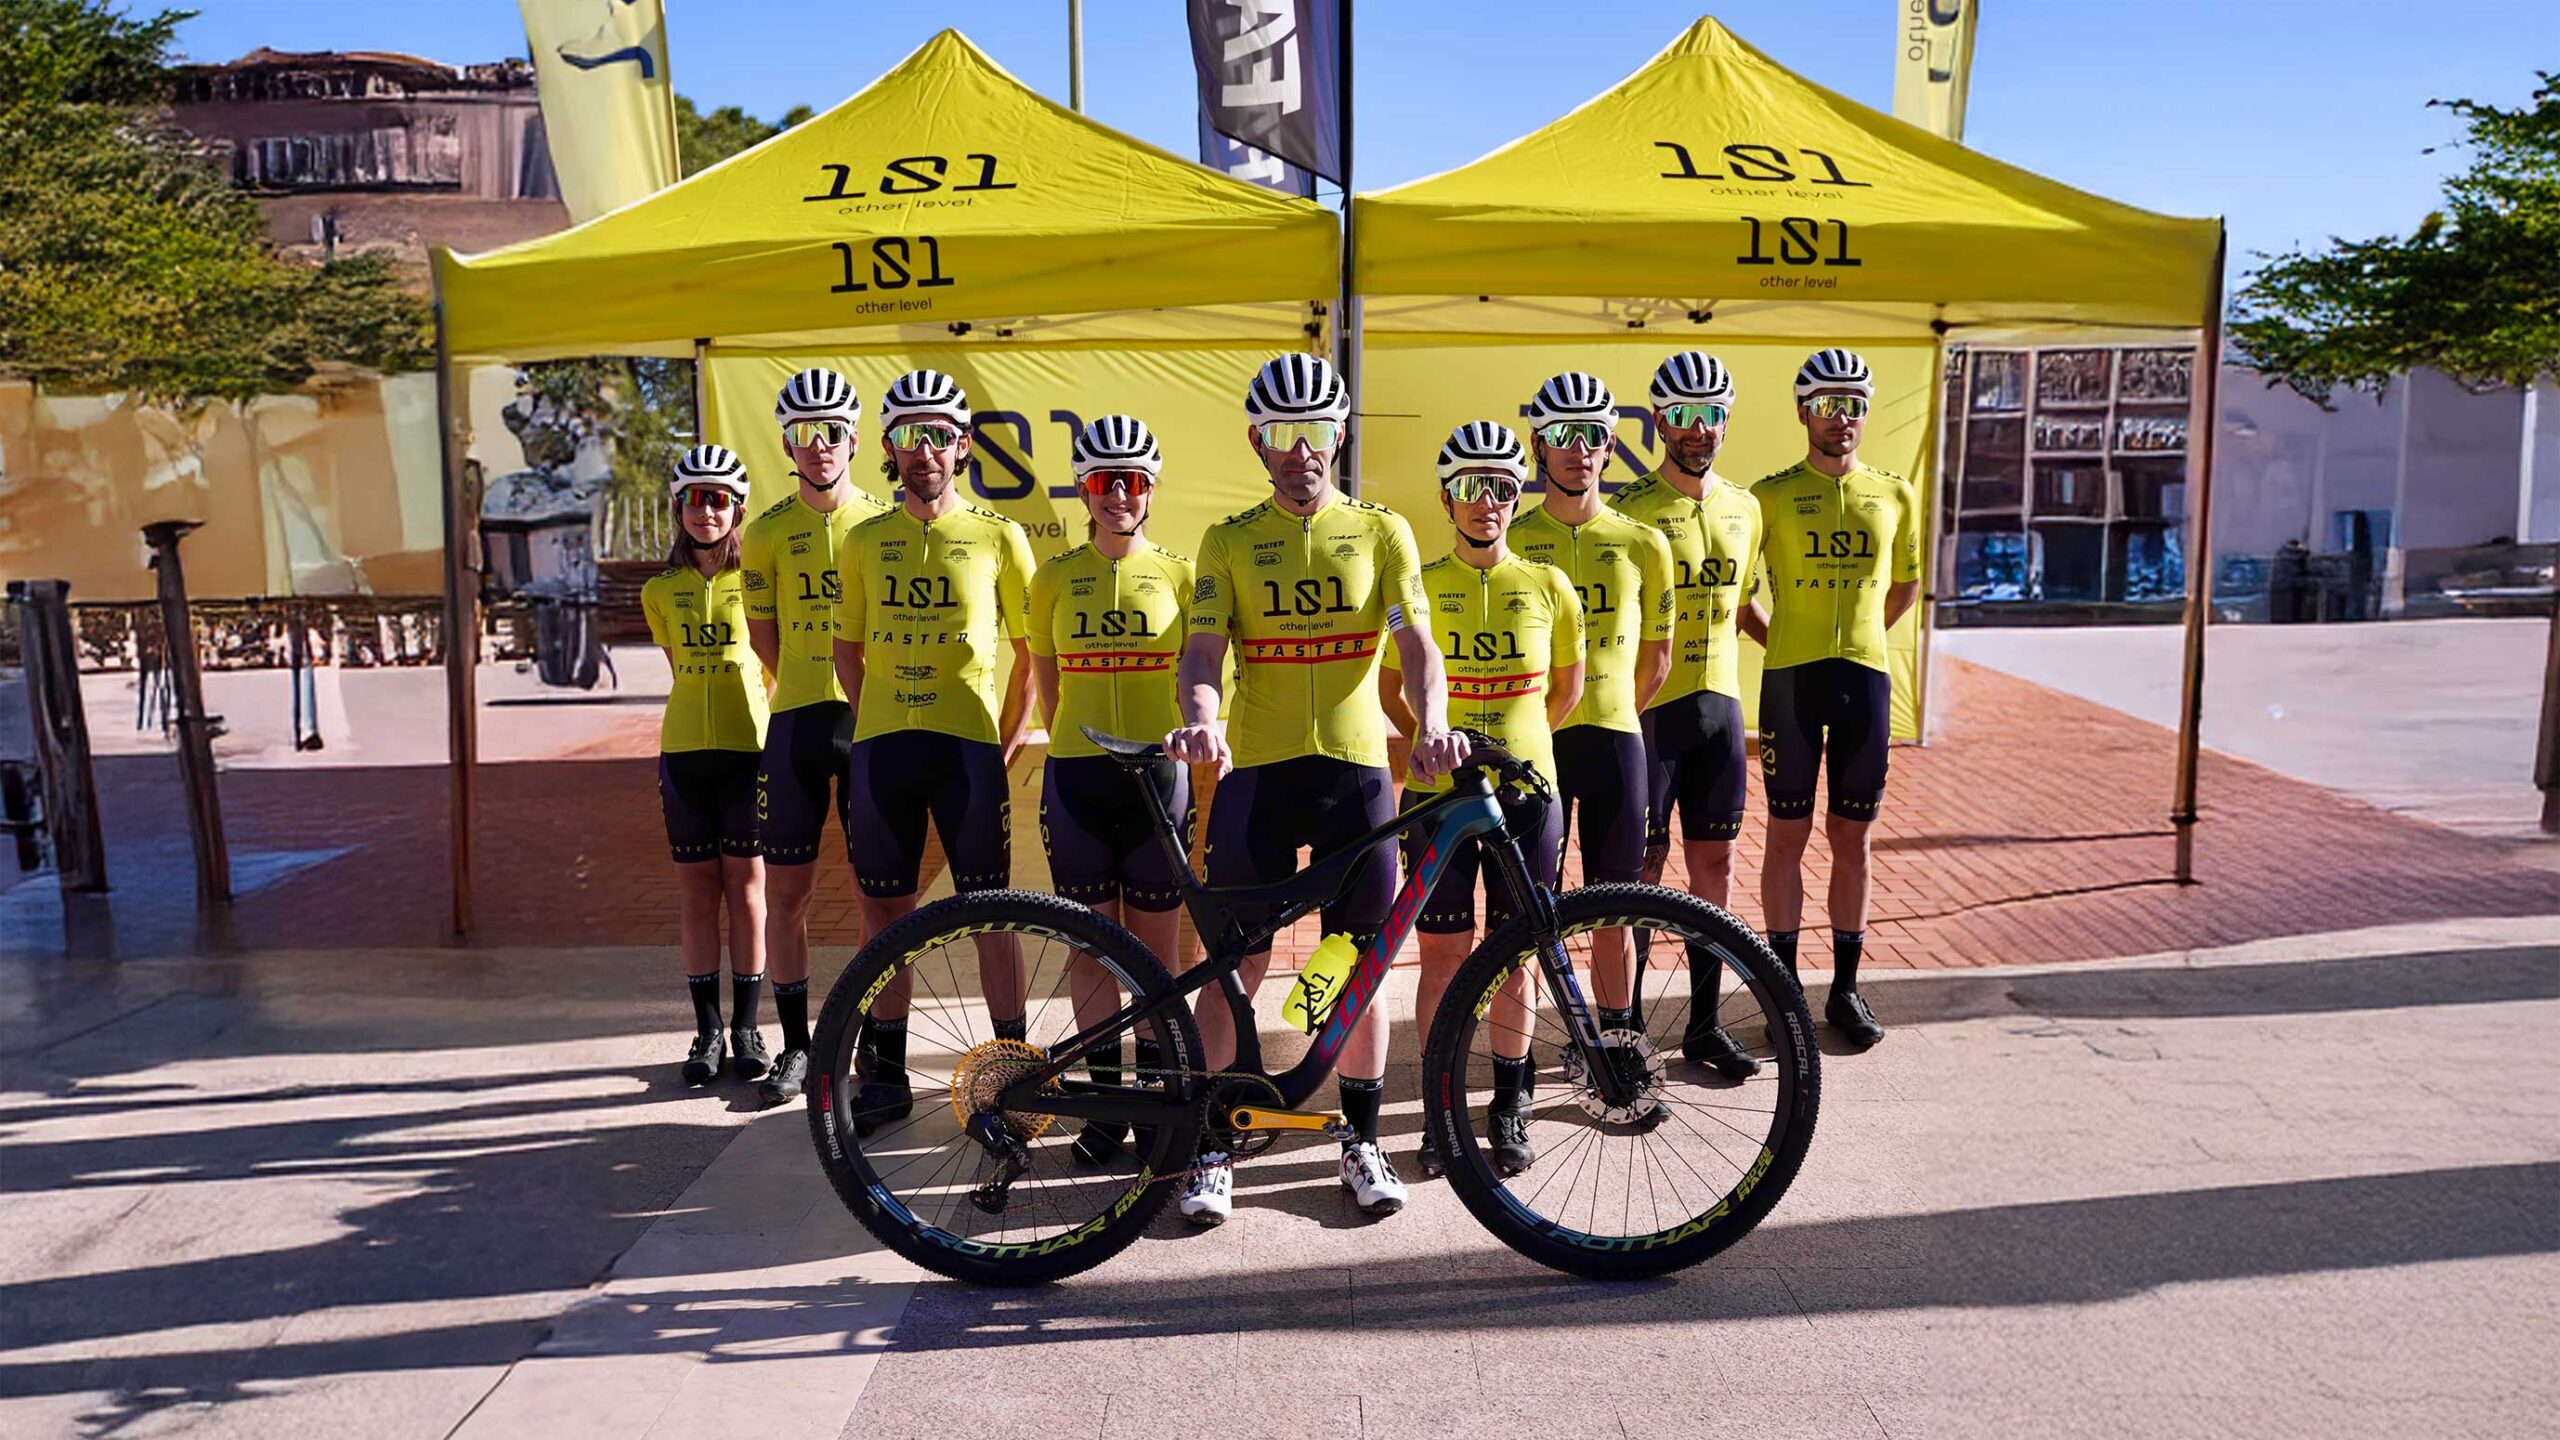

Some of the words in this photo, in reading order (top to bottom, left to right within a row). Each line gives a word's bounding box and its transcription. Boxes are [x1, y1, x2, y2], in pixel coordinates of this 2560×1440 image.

[1710, 186, 1779, 197] other
[1787, 188, 1844, 200] level
[838, 201, 909, 215] other
[916, 197, 972, 209] level
[1760, 275, 1800, 288] other
[1804, 275, 1838, 288] level
[855, 300, 896, 315] other
[900, 297, 932, 312] level
[1656, 517, 1686, 525] FASTER
[1022, 517, 1067, 539] evel
[880, 540, 907, 548] FASTER
[1253, 540, 1285, 551] FASTER
[1525, 543, 1555, 552] FASTER
[1816, 562, 1839, 570] other
[1071, 577, 1097, 585] FASTER
[1795, 579, 1878, 590] FASTER
[1438, 592, 1466, 600] FASTER
[893, 613, 917, 622] other
[919, 613, 940, 622] level
[1678, 609, 1731, 622] ASTE
[792, 621, 830, 632] FAS
[1279, 622, 1307, 632] other
[1310, 619, 1334, 631] level
[872, 631, 968, 645] FASTER
[1085, 641, 1112, 650] other
[1256, 639, 1364, 657] FASTER
[1068, 657, 1165, 667] FASTER
[678, 663, 745, 675] FASTER
[1458, 665, 1484, 674] other
[1486, 664, 1509, 674] level
[1452, 679, 1532, 694] ASTER
[1166, 1018, 1191, 1087] RASCAL
[1785, 1011, 1809, 1081] RASCAL
[823, 1111, 843, 1160] Rubena
[1444, 1109, 1463, 1158] Rubena
[1546, 1199, 1732, 1252] ROTHAR
[919, 1215, 1108, 1260] ROTHAR
